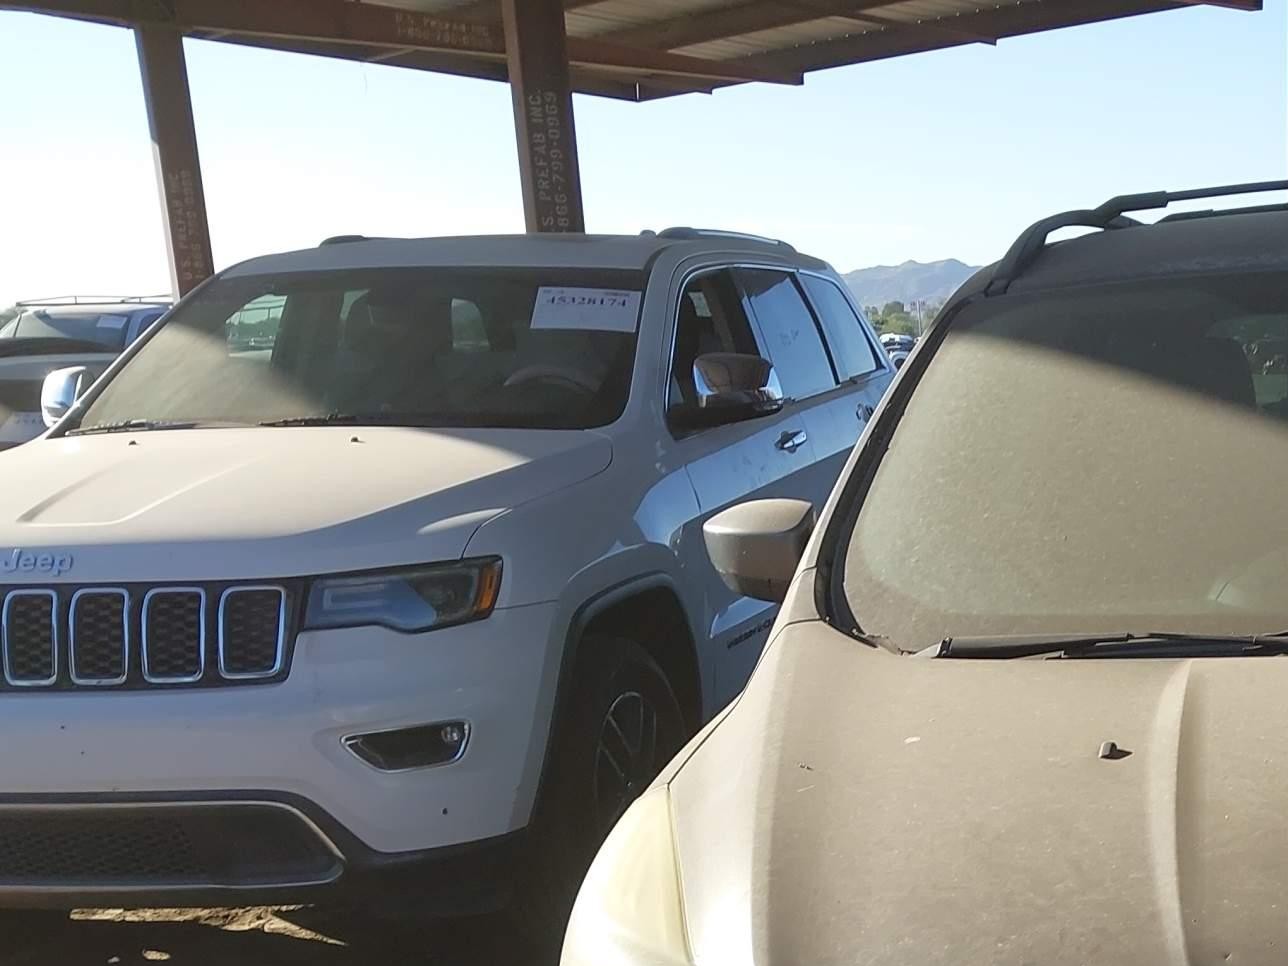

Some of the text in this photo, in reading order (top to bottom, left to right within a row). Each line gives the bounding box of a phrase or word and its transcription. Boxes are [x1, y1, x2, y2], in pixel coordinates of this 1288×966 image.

[528, 89, 544, 122] INC.
[532, 132, 551, 201] PREFAB
[543, 91, 570, 234] -866-799-0969
[2, 548, 74, 577] Jeep
